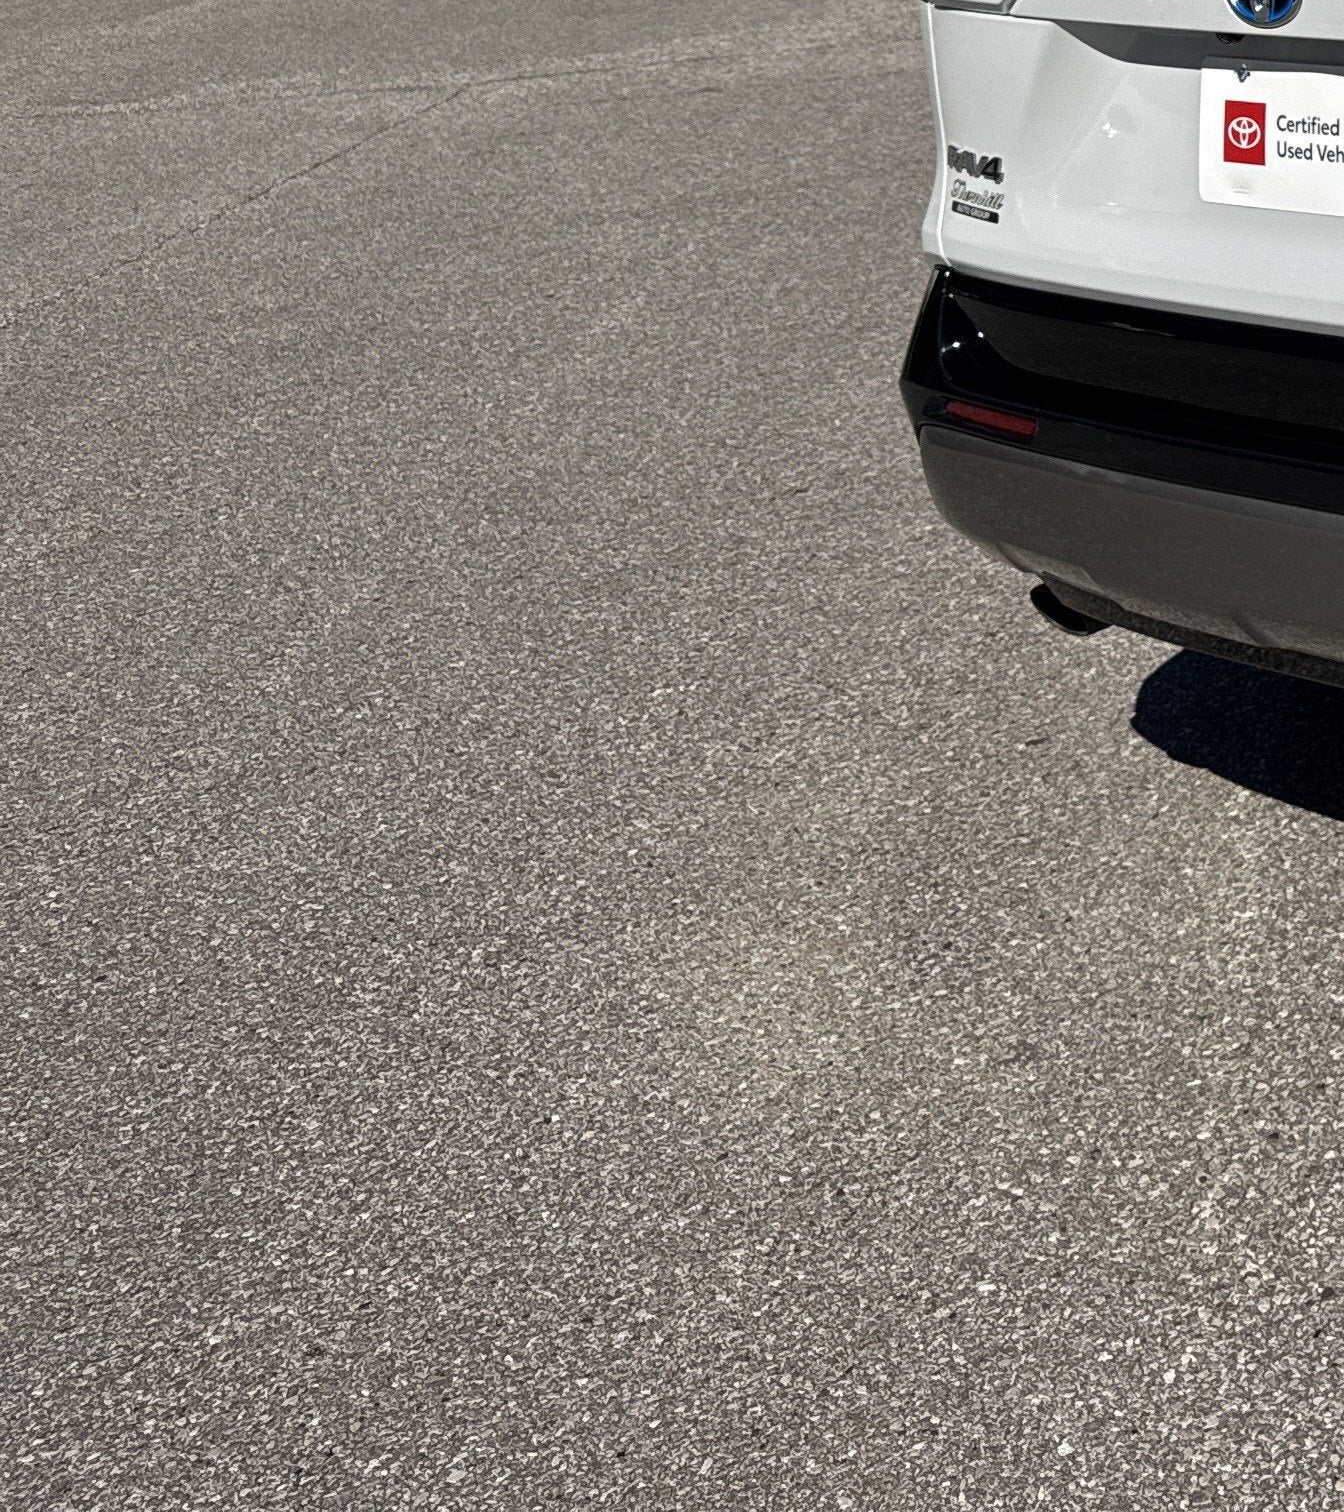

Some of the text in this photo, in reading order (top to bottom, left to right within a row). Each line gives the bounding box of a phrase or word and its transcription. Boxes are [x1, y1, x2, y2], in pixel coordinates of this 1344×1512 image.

[1276, 114, 1340, 136] Certified
[1276, 140, 1313, 161] Used
[947, 144, 1005, 185] RAV4
